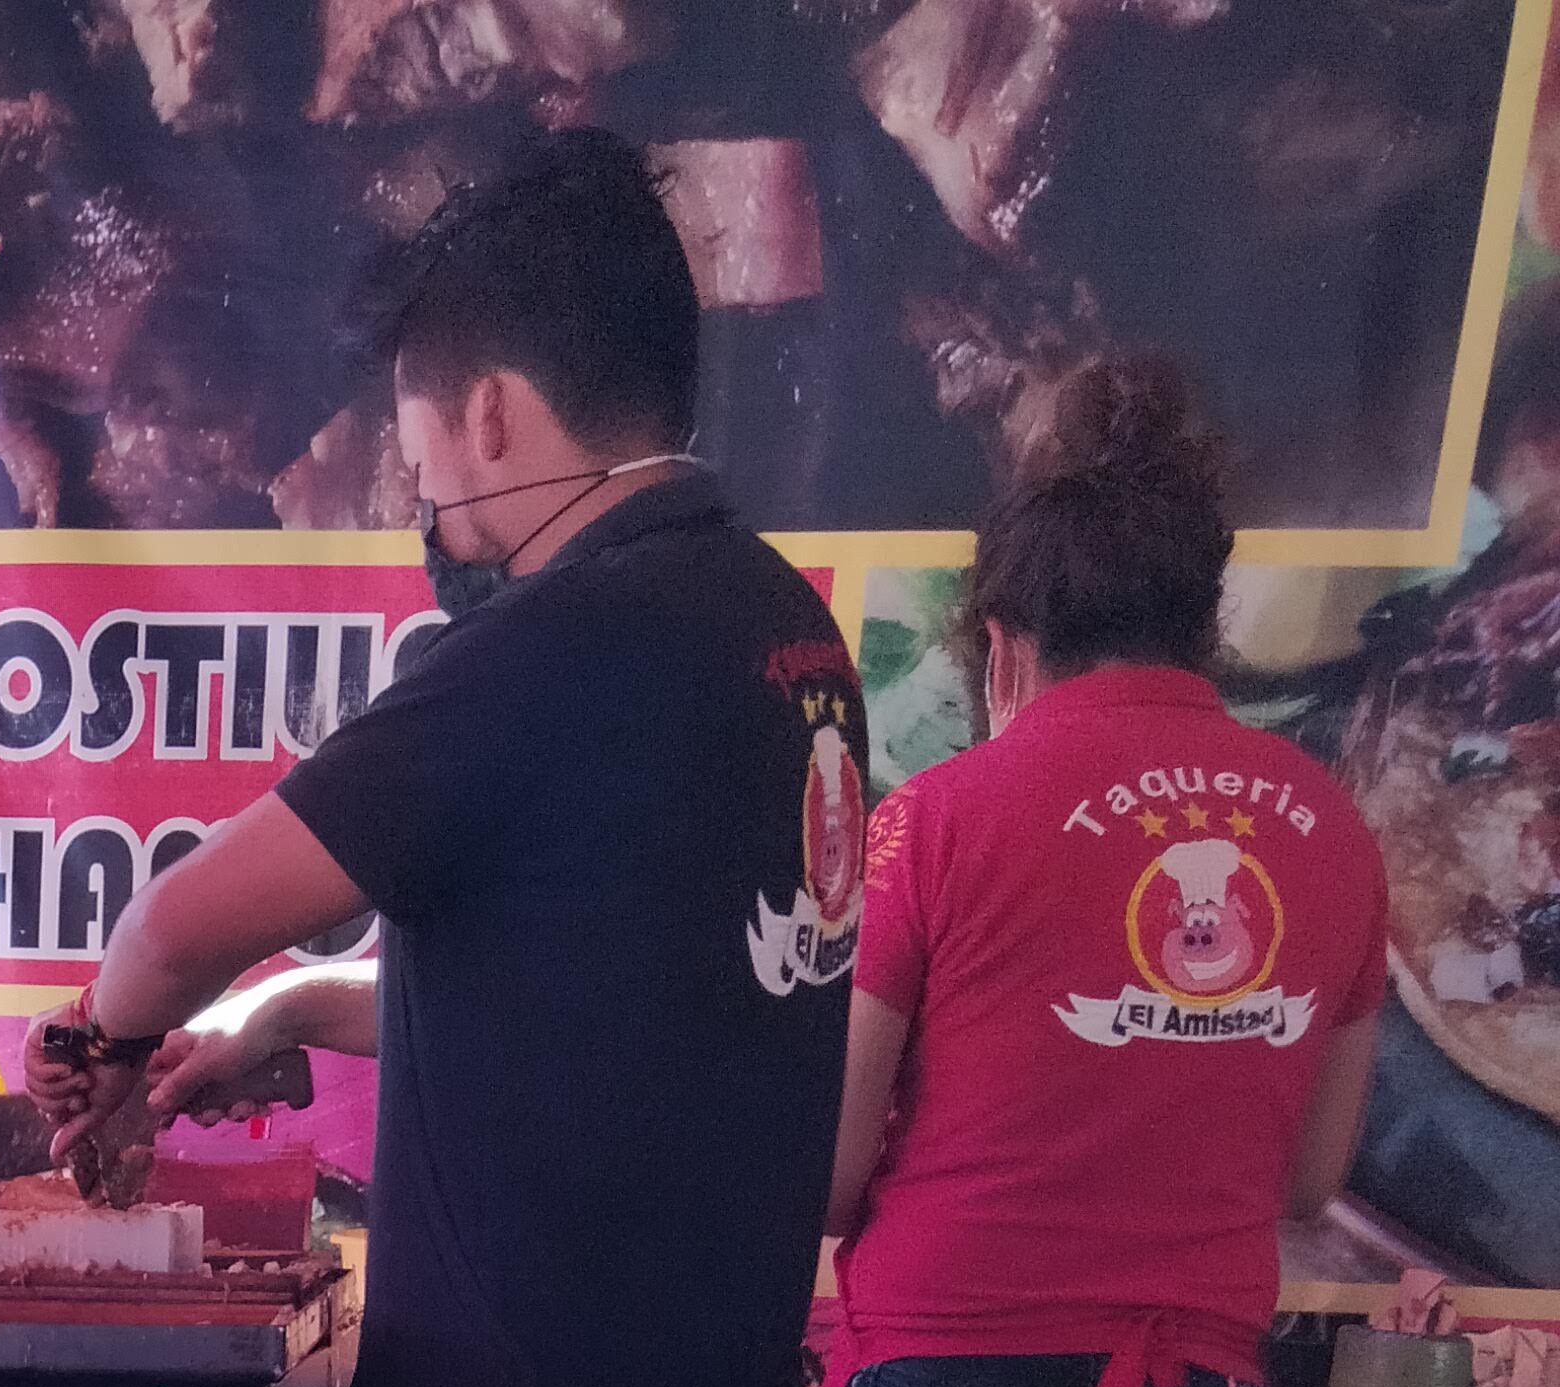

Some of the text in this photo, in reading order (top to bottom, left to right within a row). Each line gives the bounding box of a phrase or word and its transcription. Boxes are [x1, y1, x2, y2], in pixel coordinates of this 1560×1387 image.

[1062, 765, 1317, 837] Taqueria
[1128, 1003, 1274, 1036] El Amistad
